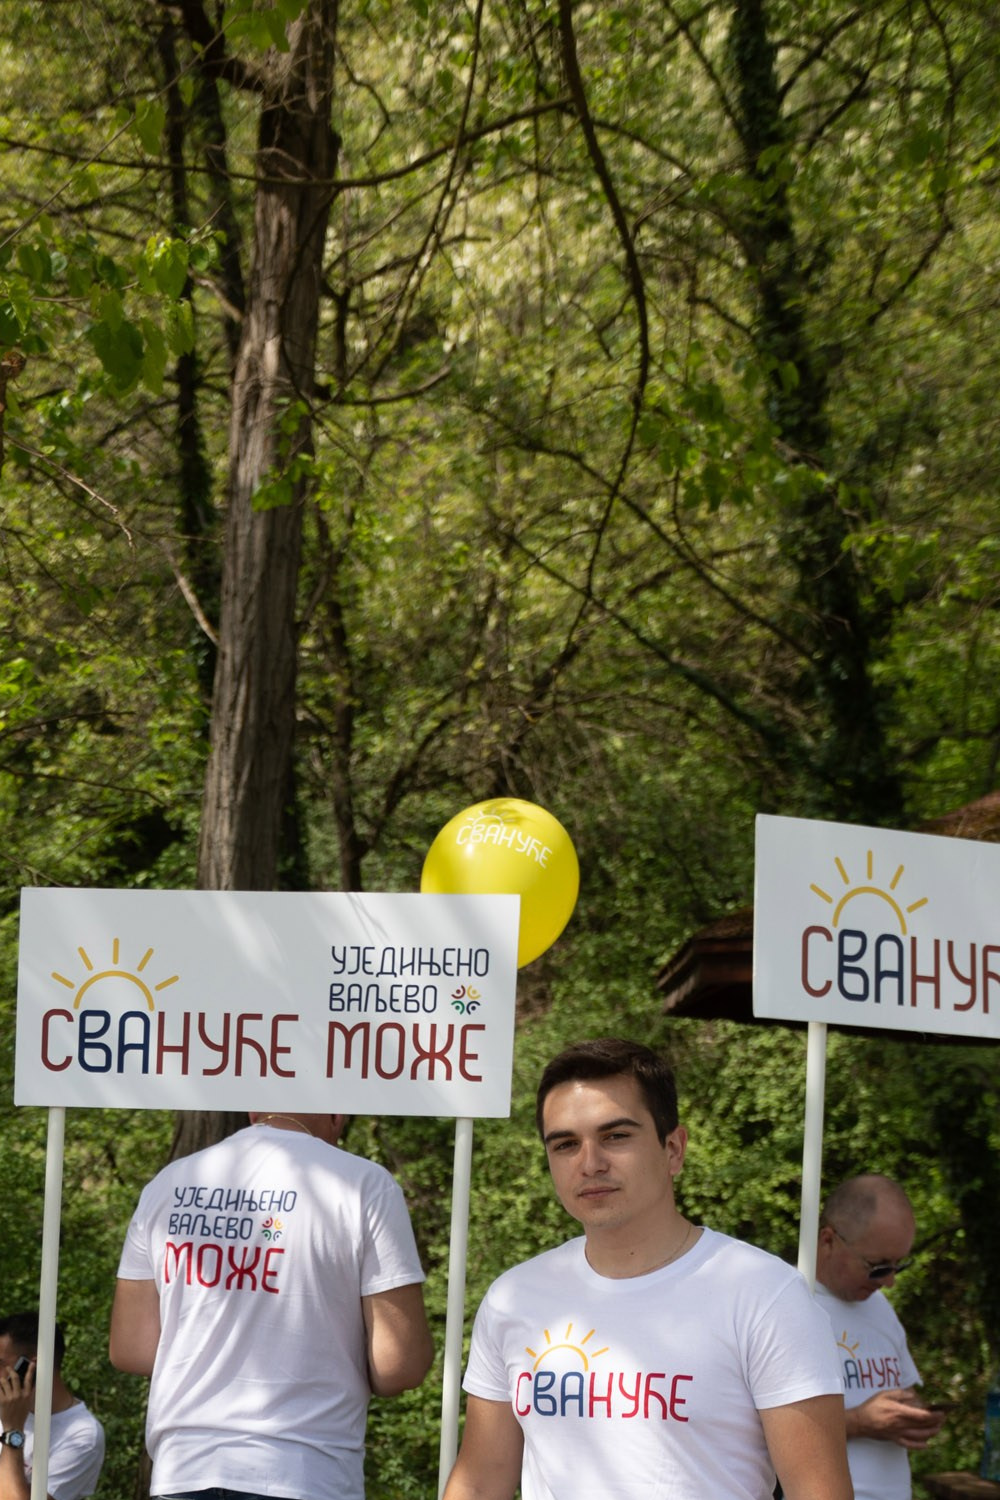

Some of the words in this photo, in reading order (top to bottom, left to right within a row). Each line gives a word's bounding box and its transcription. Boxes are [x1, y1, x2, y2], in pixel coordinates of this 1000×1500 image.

[456, 823, 553, 869] СВАНУЋЕ
[331, 945, 490, 977] УЈЕДИЊЕНО
[328, 983, 438, 1014] ВАЉЕВО
[40, 1007, 299, 1078] СВАНУЋЕ
[326, 1021, 486, 1082] МОЖЕ
[174, 1186, 297, 1212] УЈЕДИЊЕНО
[168, 1213, 254, 1240] ВАЉЕВО
[164, 1242, 285, 1294] МОЖЕ
[515, 1371, 694, 1423] СВАНУЋЕ
